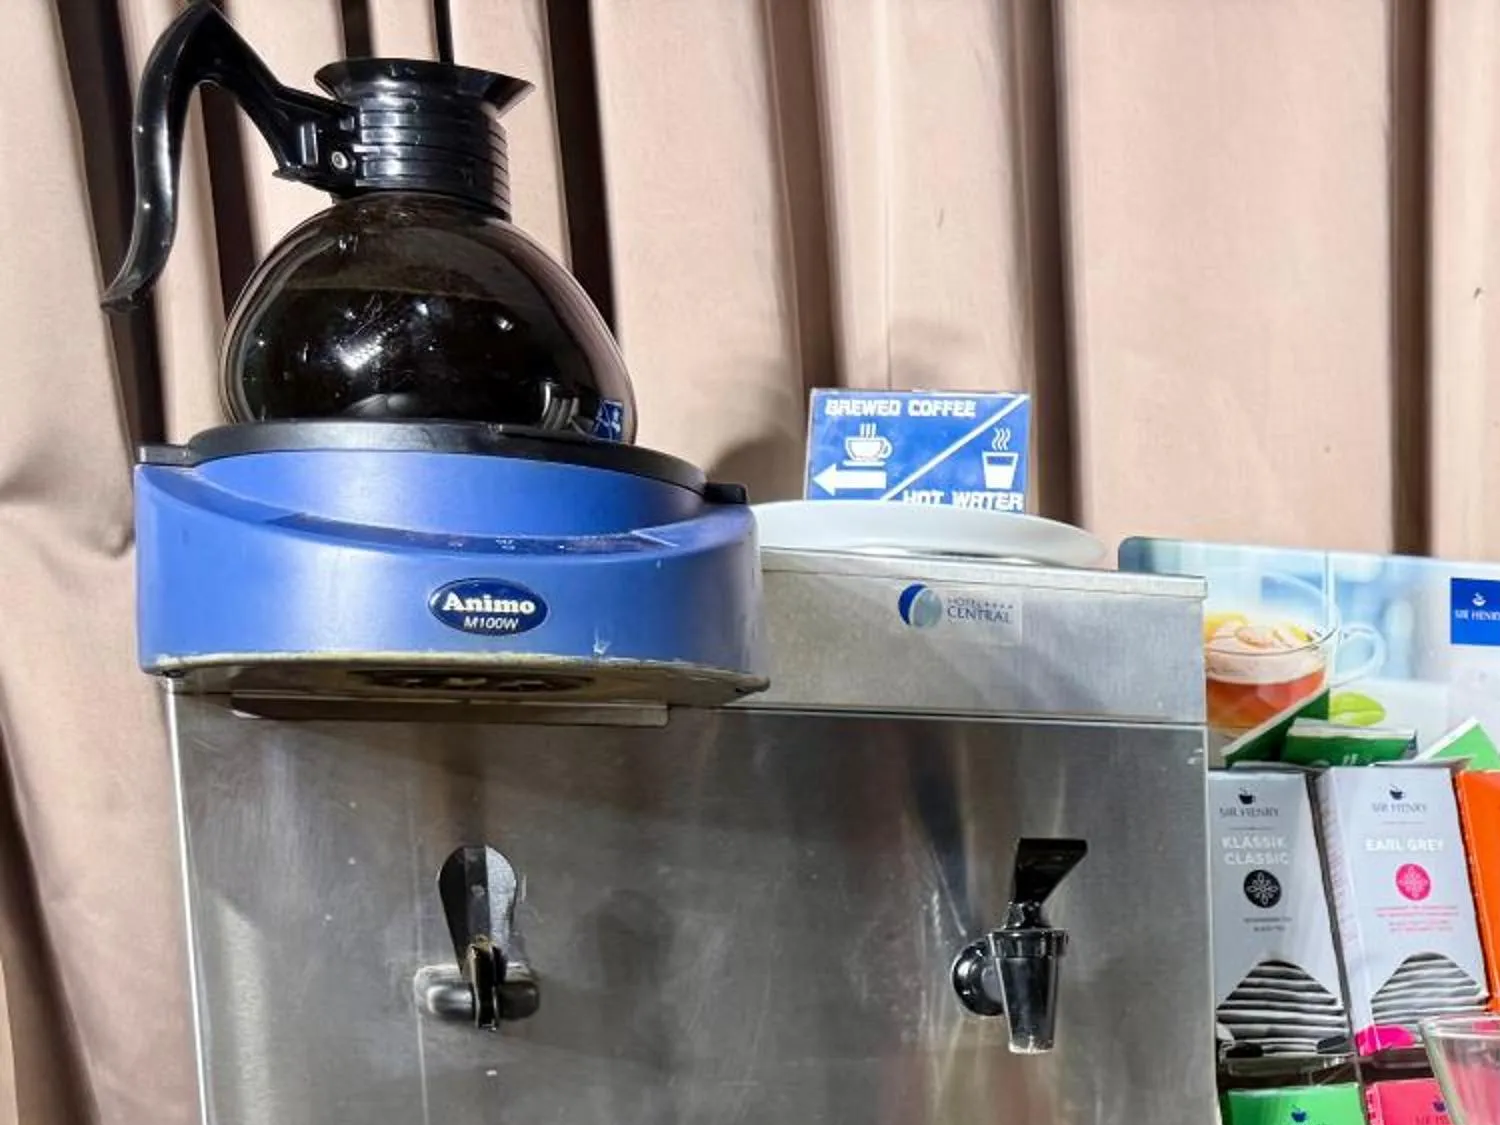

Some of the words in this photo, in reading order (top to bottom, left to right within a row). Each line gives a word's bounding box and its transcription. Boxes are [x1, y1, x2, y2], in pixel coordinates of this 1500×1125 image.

[824, 398, 902, 417] BREWED
[907, 399, 977, 419] COFFEE
[951, 490, 1024, 513] WATER
[442, 592, 537, 616] Animo
[946, 605, 1011, 623] CENTRAL
[463, 615, 519, 632] M100W
[1221, 835, 1286, 850] KLASSIK
[1365, 838, 1404, 852] EARL
[1407, 838, 1445, 852] GREY
[1224, 851, 1290, 866] CLASSIC
